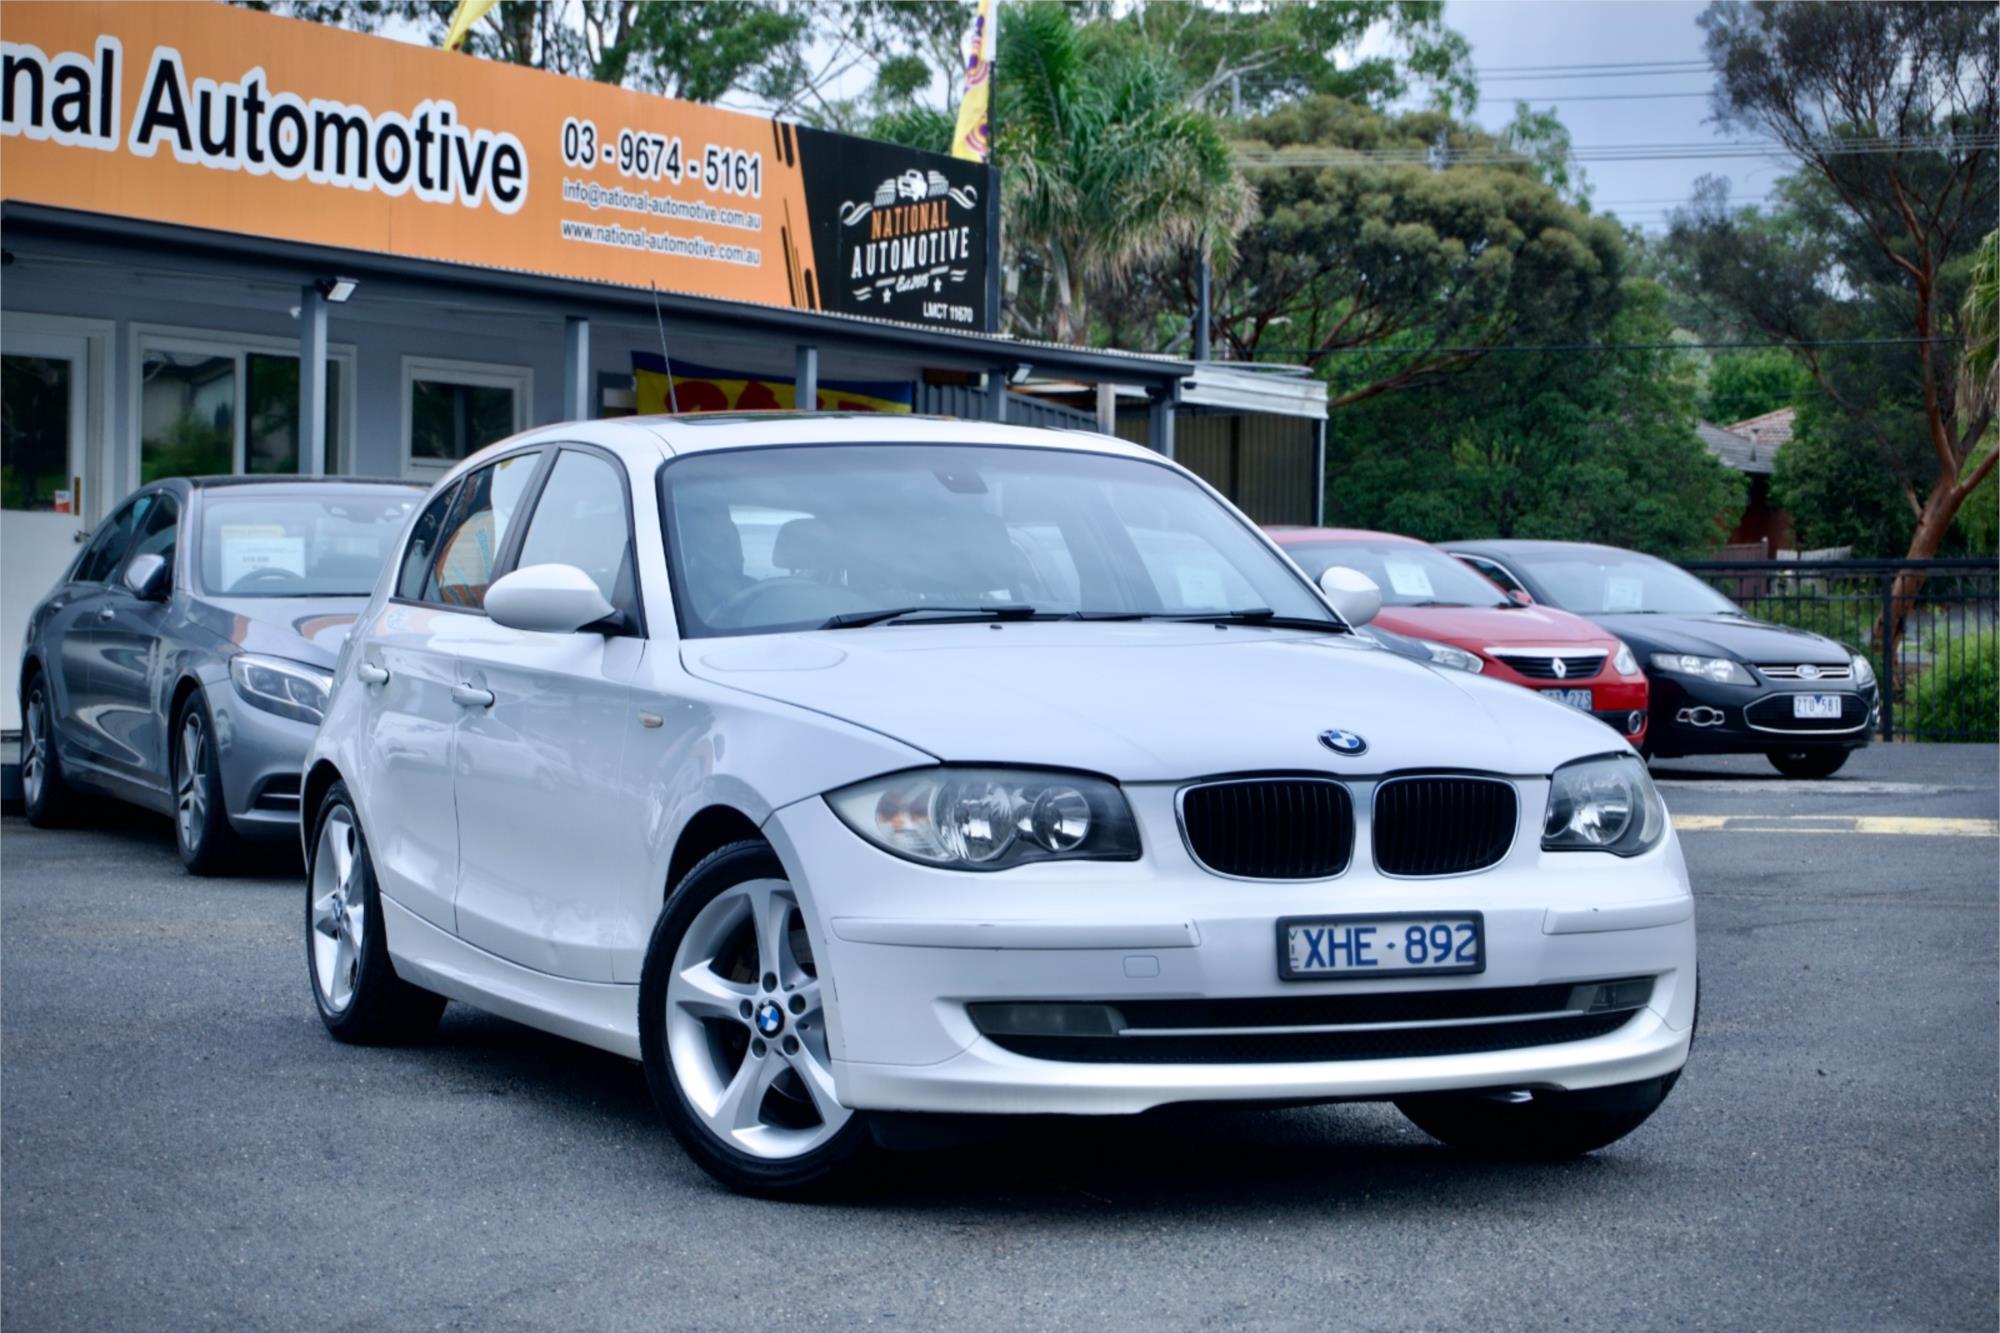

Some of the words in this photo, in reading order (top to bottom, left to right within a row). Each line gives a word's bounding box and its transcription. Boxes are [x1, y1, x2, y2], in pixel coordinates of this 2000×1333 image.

[2, 47, 115, 139] nal
[136, 58, 522, 203] Automotive
[564, 122, 595, 164] 03
[620, 133, 681, 180] 9674
[705, 149, 760, 193] 5161
[563, 182, 761, 229] info@national-automotive.com.au
[870, 200, 949, 240] NATIONAL
[561, 221, 760, 265] www.national-automotive.com.au
[851, 226, 969, 279] AUTOMOTIVE
